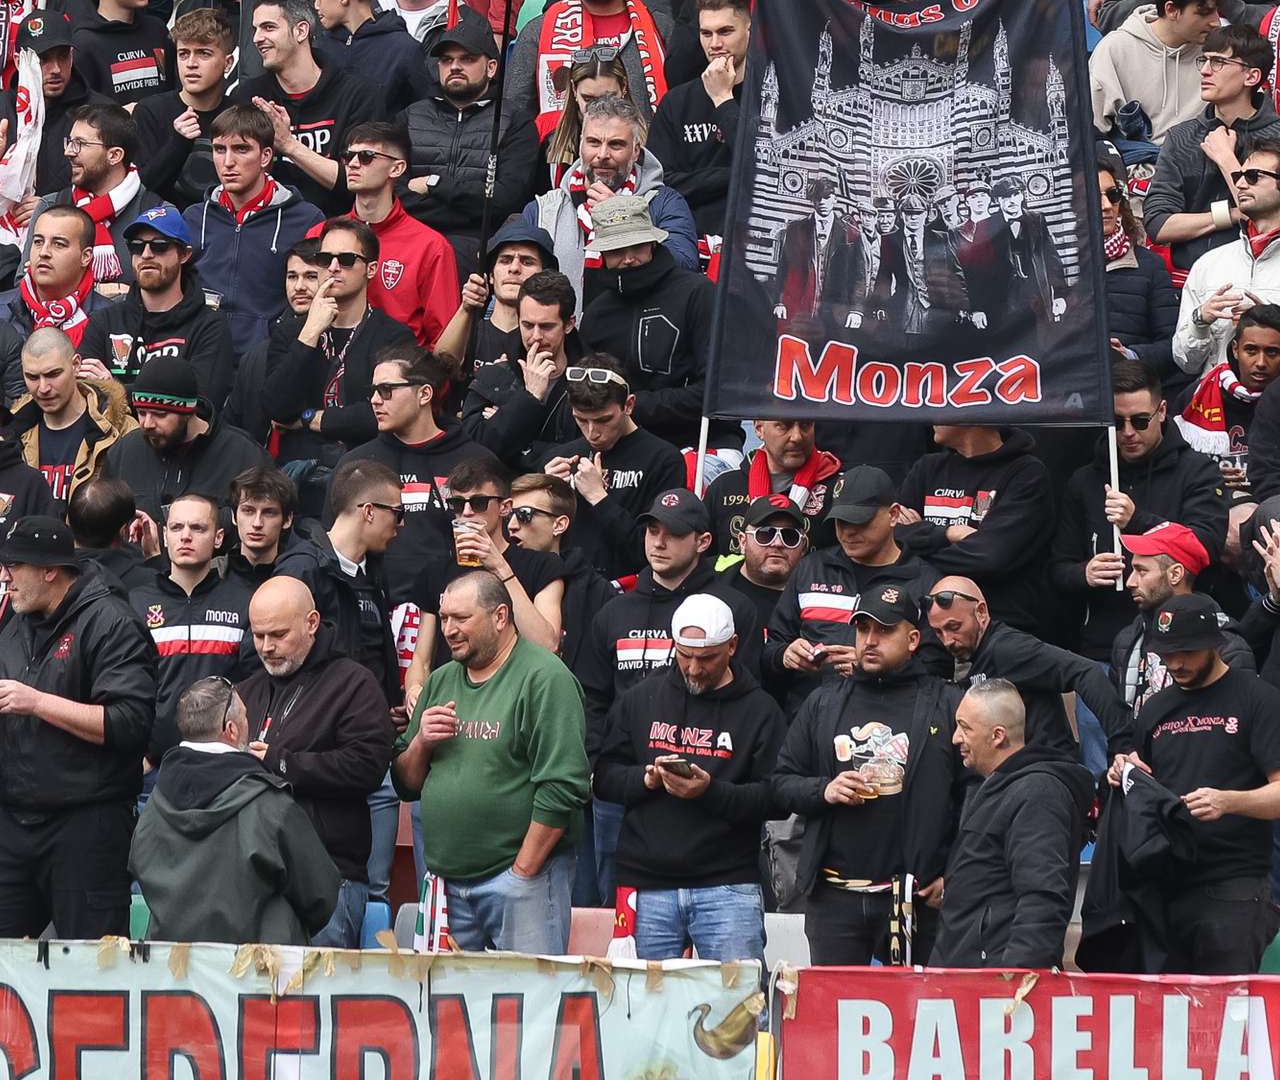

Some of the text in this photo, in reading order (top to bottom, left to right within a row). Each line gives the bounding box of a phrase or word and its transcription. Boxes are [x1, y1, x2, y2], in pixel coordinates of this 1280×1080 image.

[117, 51, 147, 62] CURVA
[114, 80, 144, 93] DAVIDE
[291, 128, 331, 155] DP
[773, 333, 1044, 409] Monza
[404, 502, 428, 513] PIERI
[205, 610, 240, 624] MONZA
[628, 629, 668, 640] CURVA
[837, 994, 1277, 1080] BARELLA
